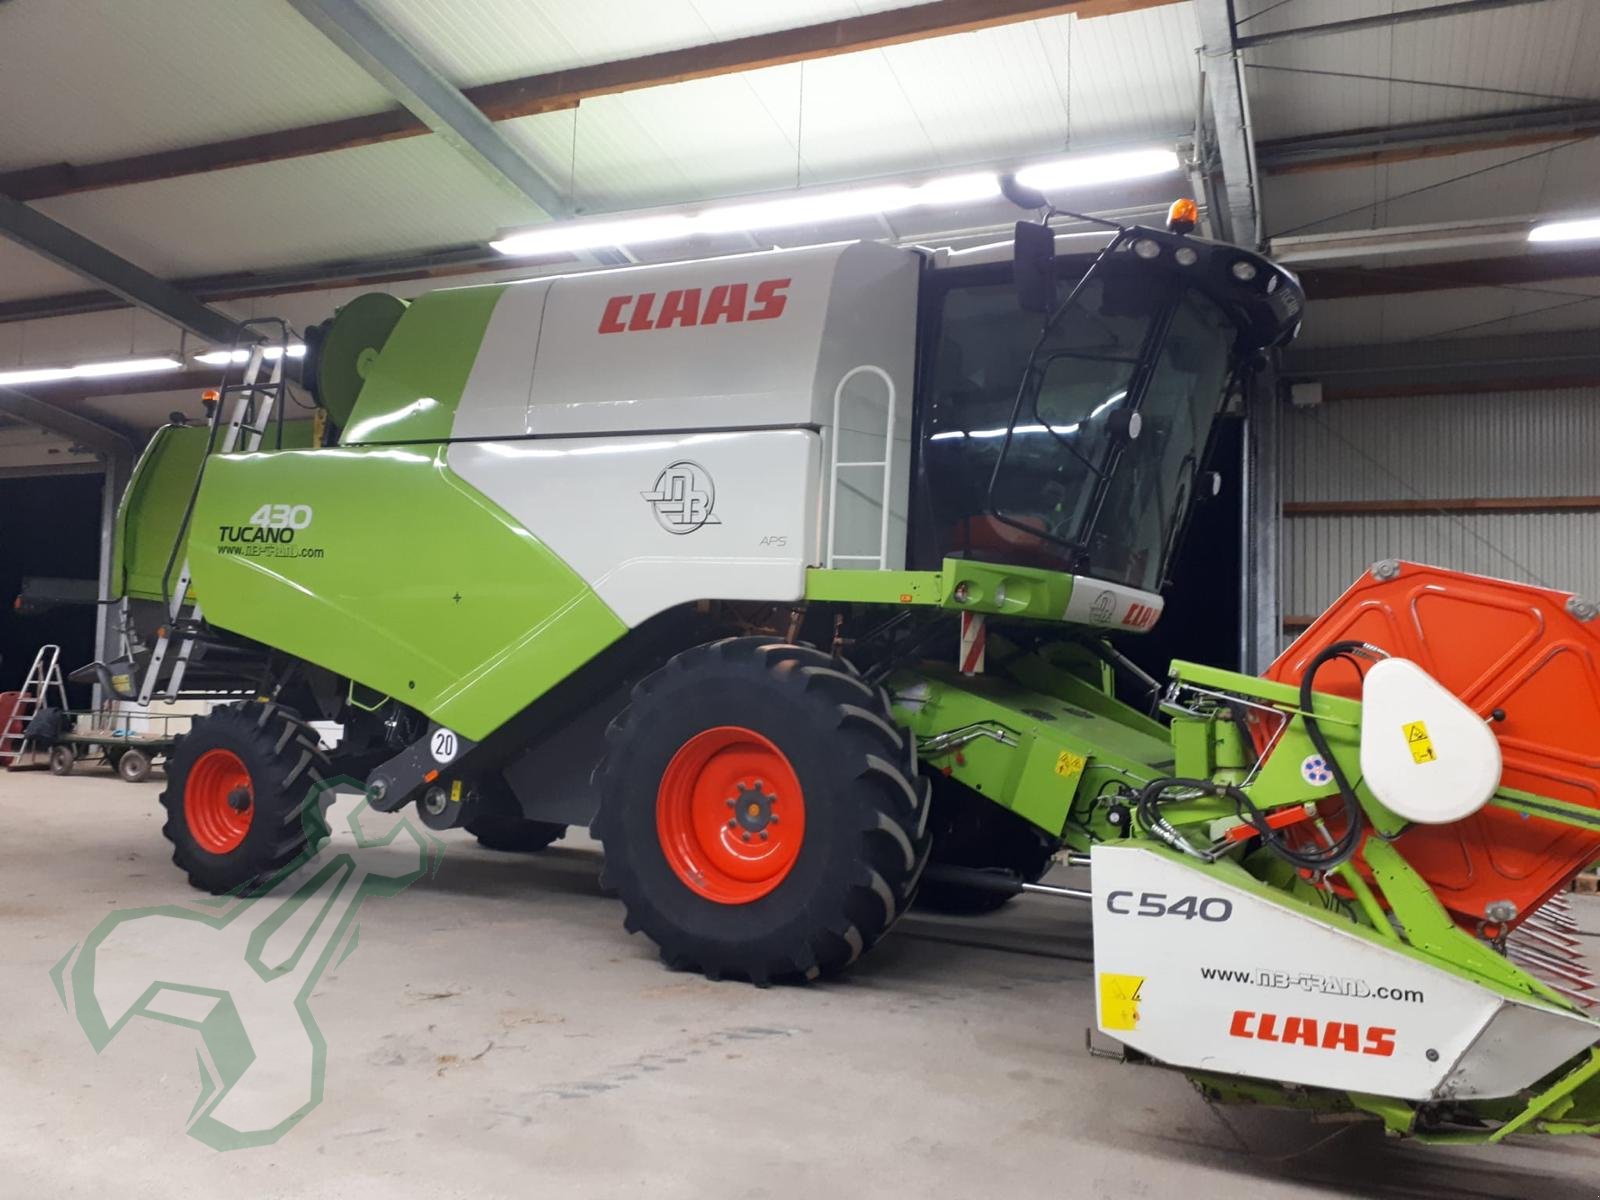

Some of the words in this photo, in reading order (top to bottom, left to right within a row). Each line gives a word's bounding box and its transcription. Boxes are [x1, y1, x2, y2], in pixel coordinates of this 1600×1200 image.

[598, 278, 791, 334] CLAAS
[249, 503, 313, 530] 430
[219, 526, 295, 543] TUCANO
[759, 535, 788, 547] APS
[435, 733, 453, 756] 20
[1229, 1010, 1396, 1057] CLAAS
